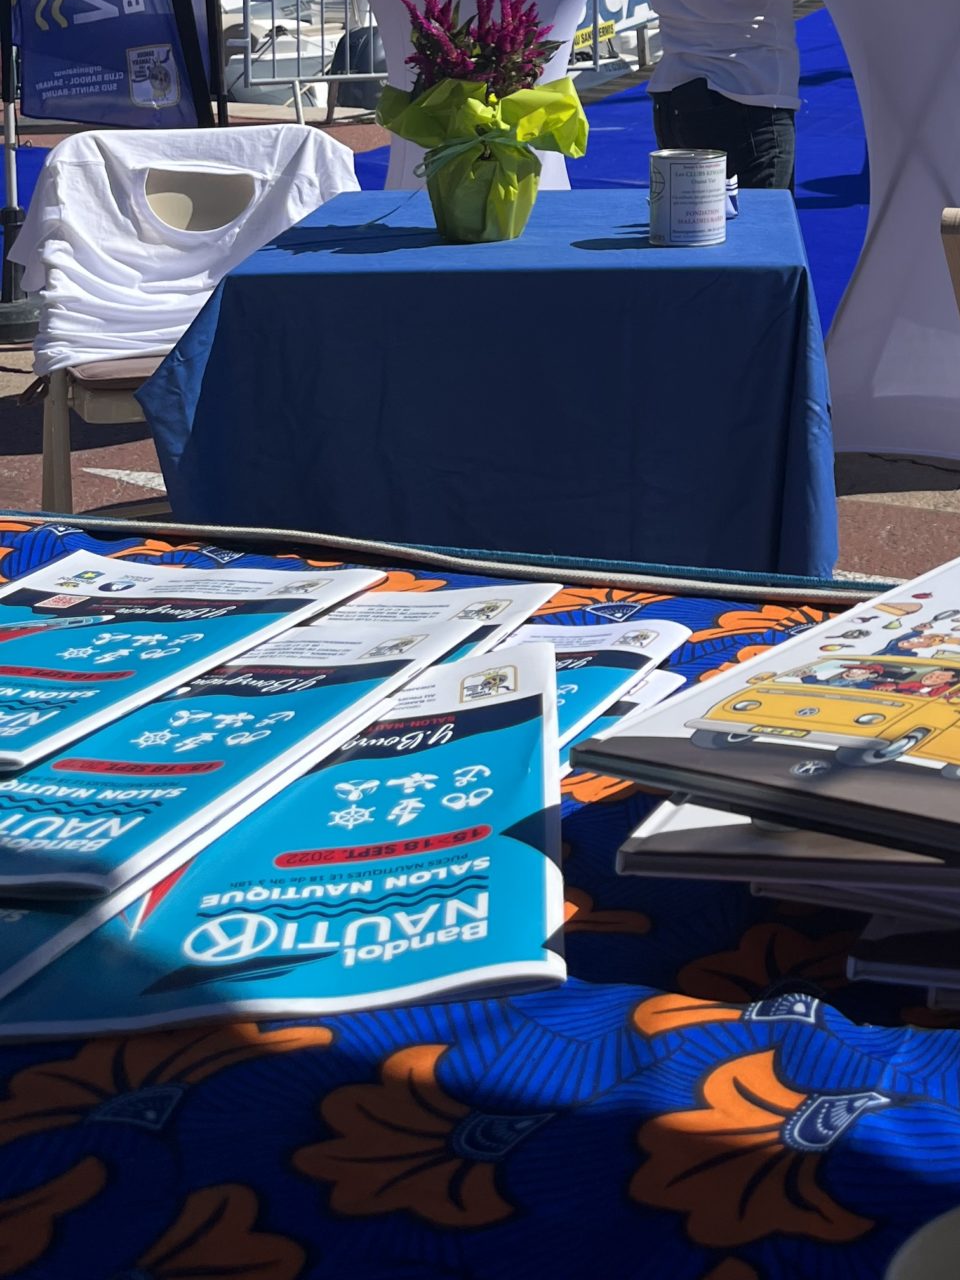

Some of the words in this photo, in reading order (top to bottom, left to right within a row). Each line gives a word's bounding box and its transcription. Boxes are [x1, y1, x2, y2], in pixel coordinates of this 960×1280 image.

[22, 689, 101, 699] SALON
[97, 787, 188, 800] SALON
[286, 849, 335, 865] 2022
[344, 843, 398, 859] SEPT.
[385, 855, 490, 890] SALON
[199, 879, 373, 908] NAUTIQUE
[344, 920, 488, 967] Bandol
